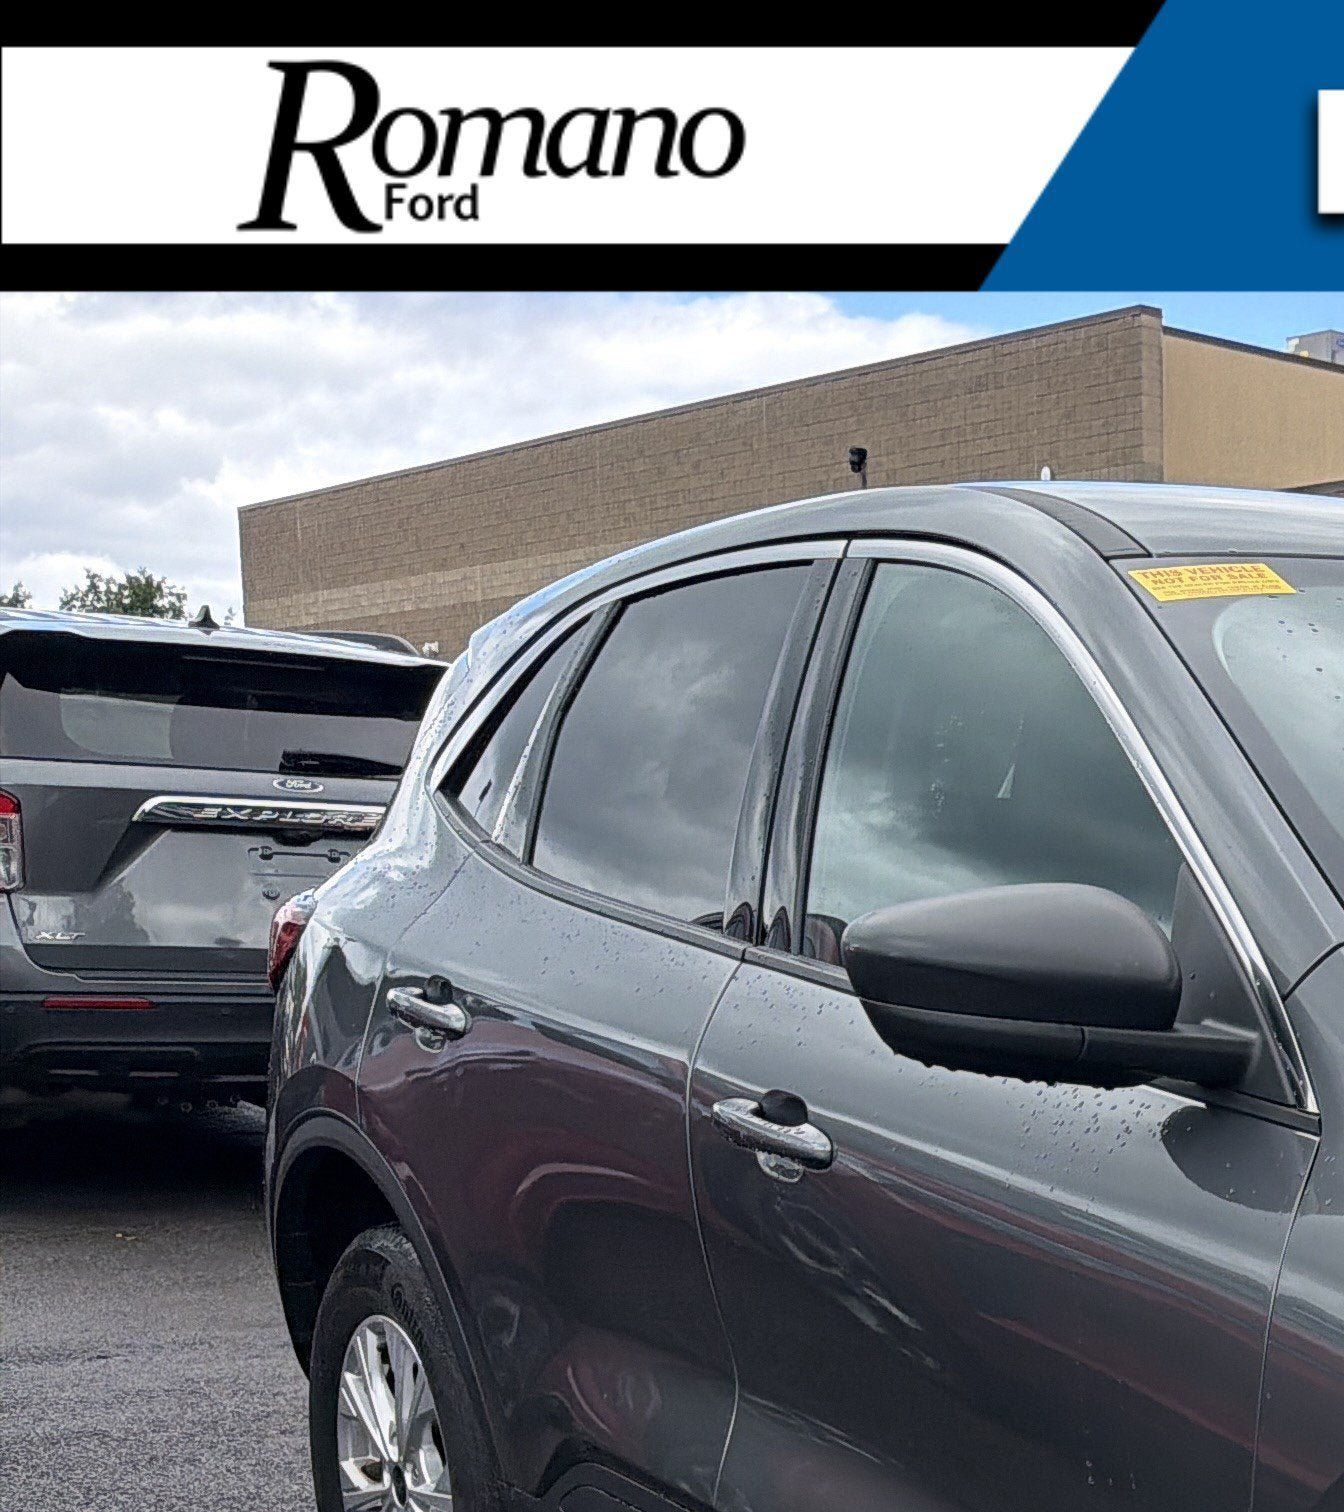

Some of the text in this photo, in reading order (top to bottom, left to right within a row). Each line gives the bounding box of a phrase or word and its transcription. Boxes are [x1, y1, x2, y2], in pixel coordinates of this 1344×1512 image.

[1139, 565, 1264, 579] THIS VEHICLE
[193, 806, 382, 827] EXPLORE
[35, 931, 86, 941] XLT
